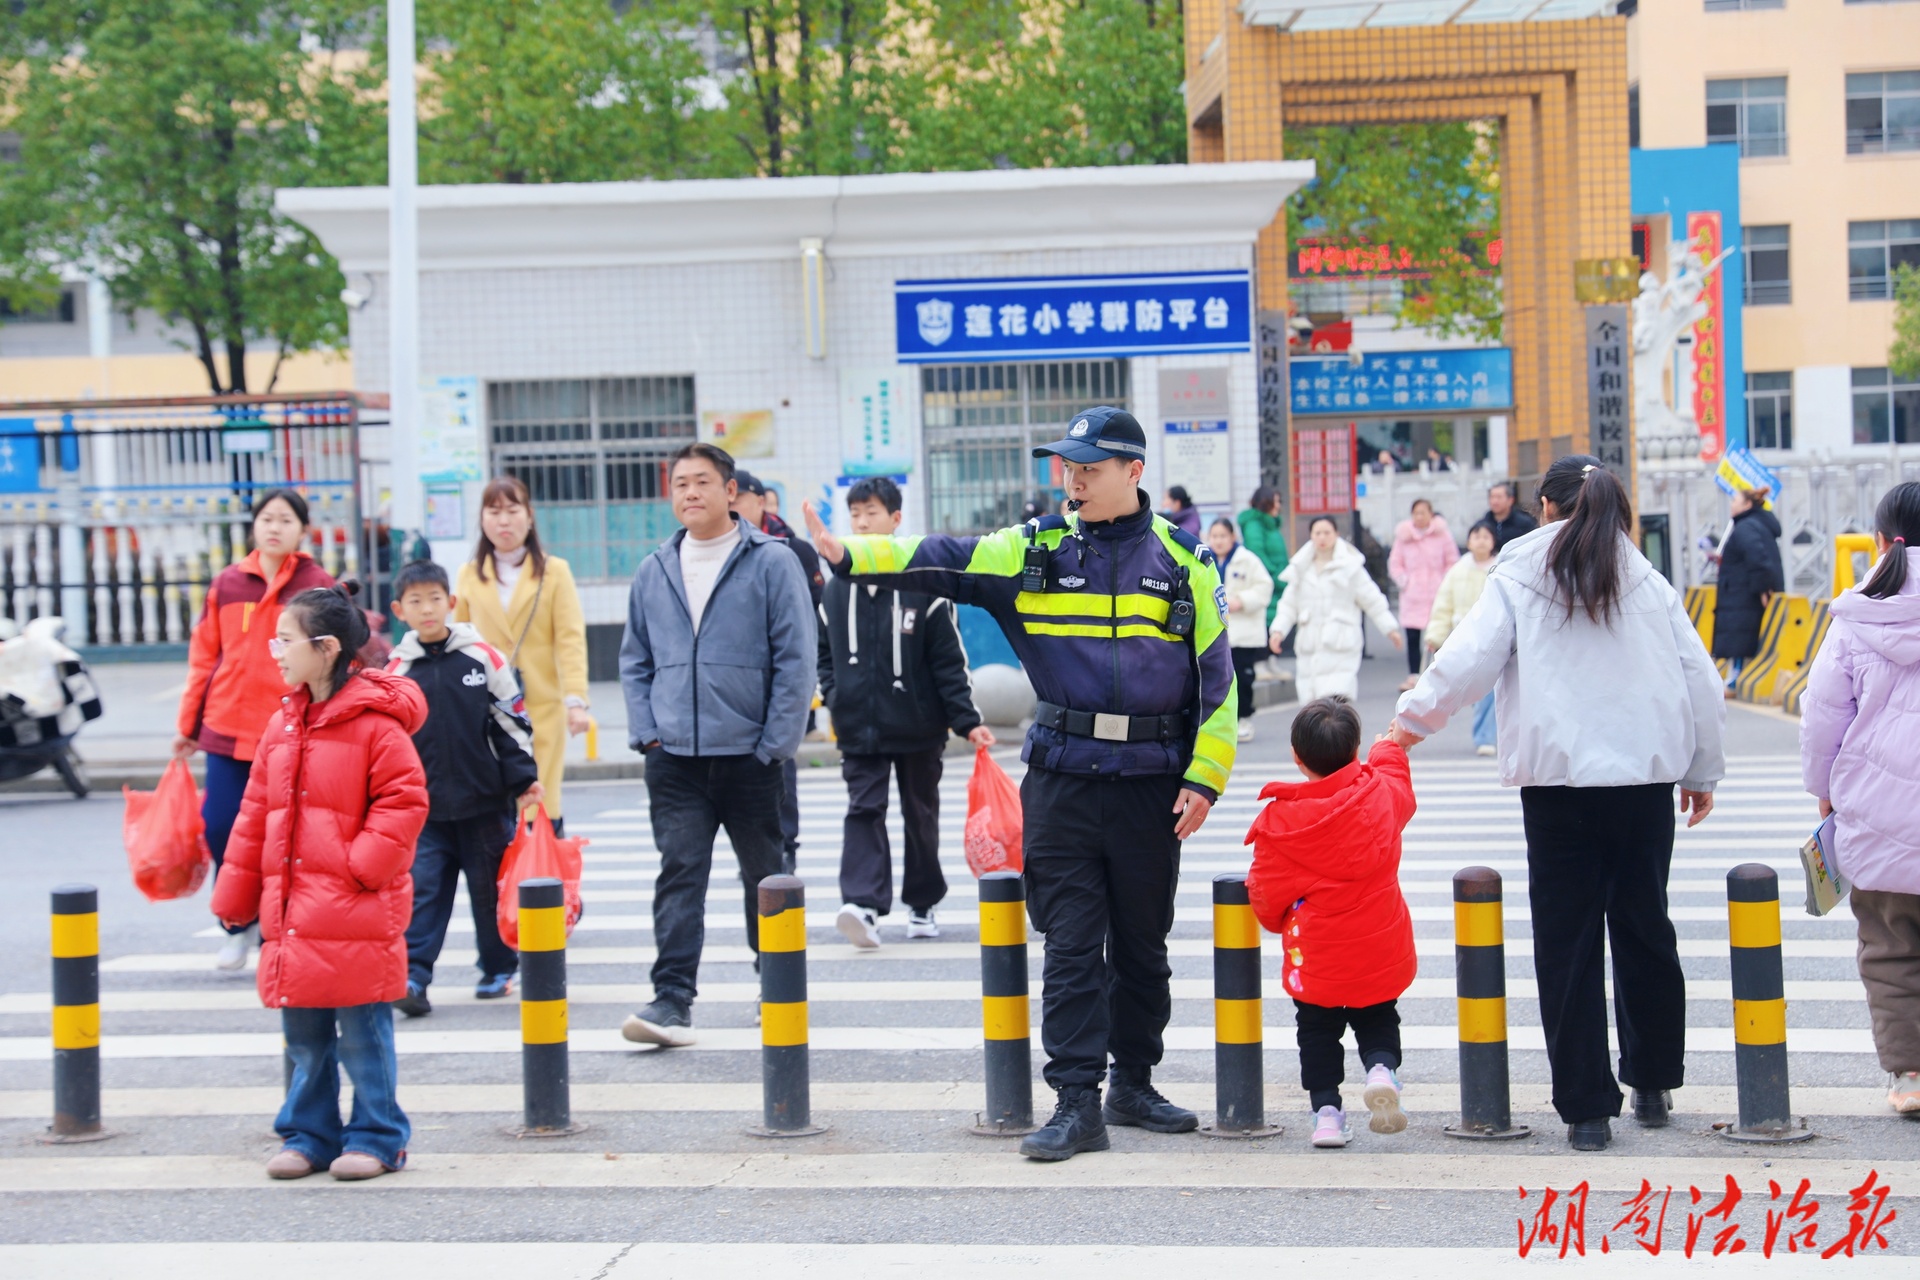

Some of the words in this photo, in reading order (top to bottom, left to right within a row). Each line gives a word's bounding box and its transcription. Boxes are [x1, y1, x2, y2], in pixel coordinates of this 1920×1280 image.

[964, 296, 1230, 338] 莲花小学群防平台
[1321, 357, 1440, 372] 封式管理
[462, 668, 487, 687] alo
